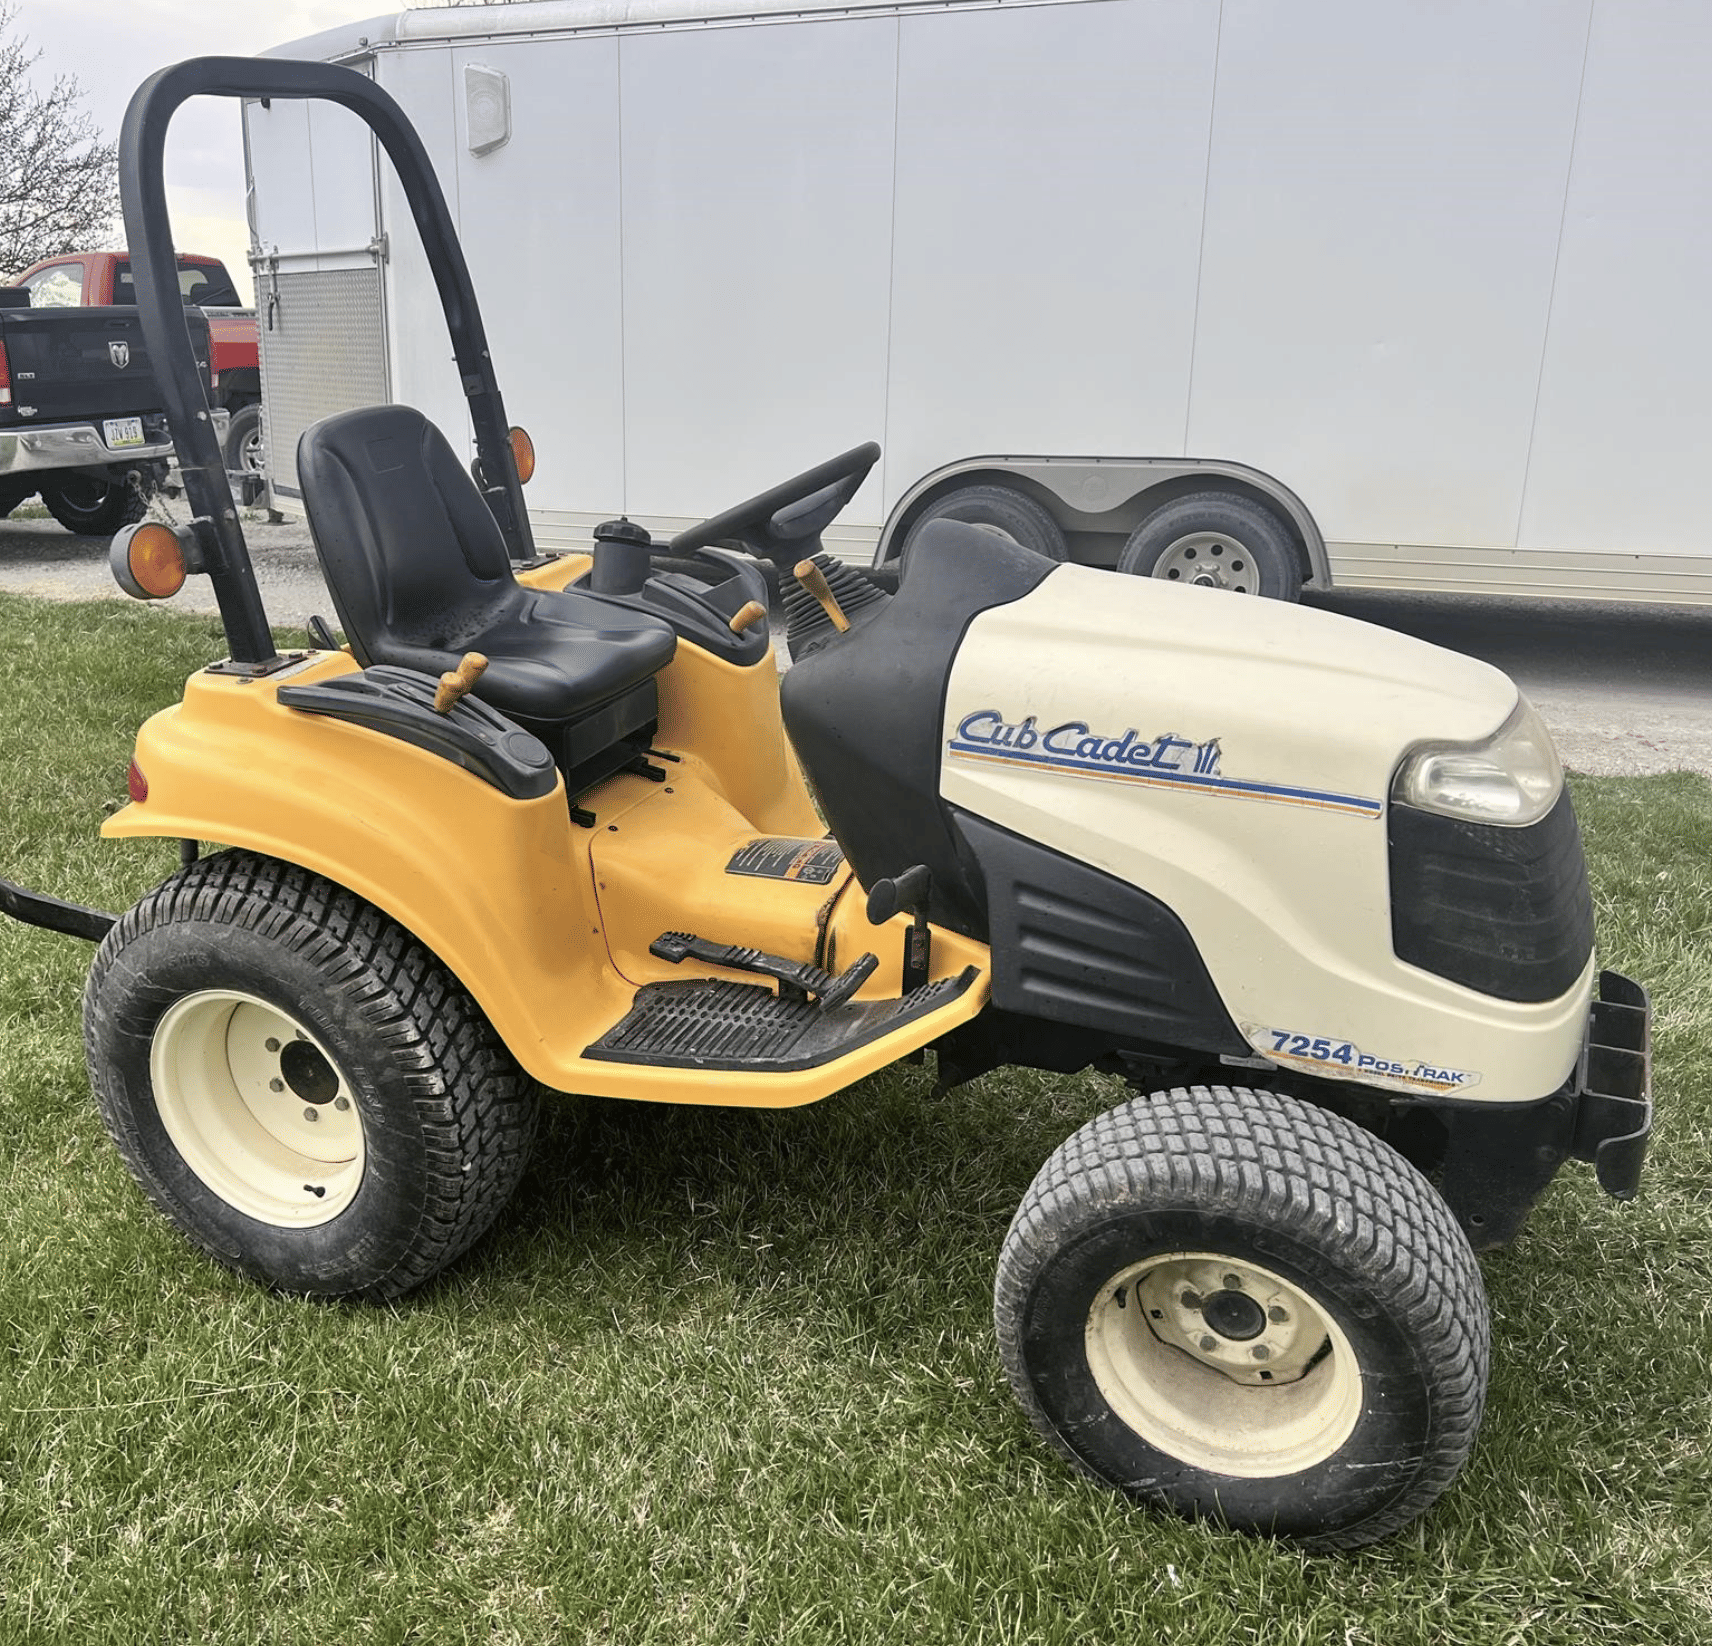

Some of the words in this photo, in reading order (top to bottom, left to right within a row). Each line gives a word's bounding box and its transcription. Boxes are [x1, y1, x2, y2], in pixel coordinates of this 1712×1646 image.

[959, 711, 1038, 750] Cub
[1043, 721, 1193, 770] Cadet
[1271, 1030, 1353, 1065] 7254
